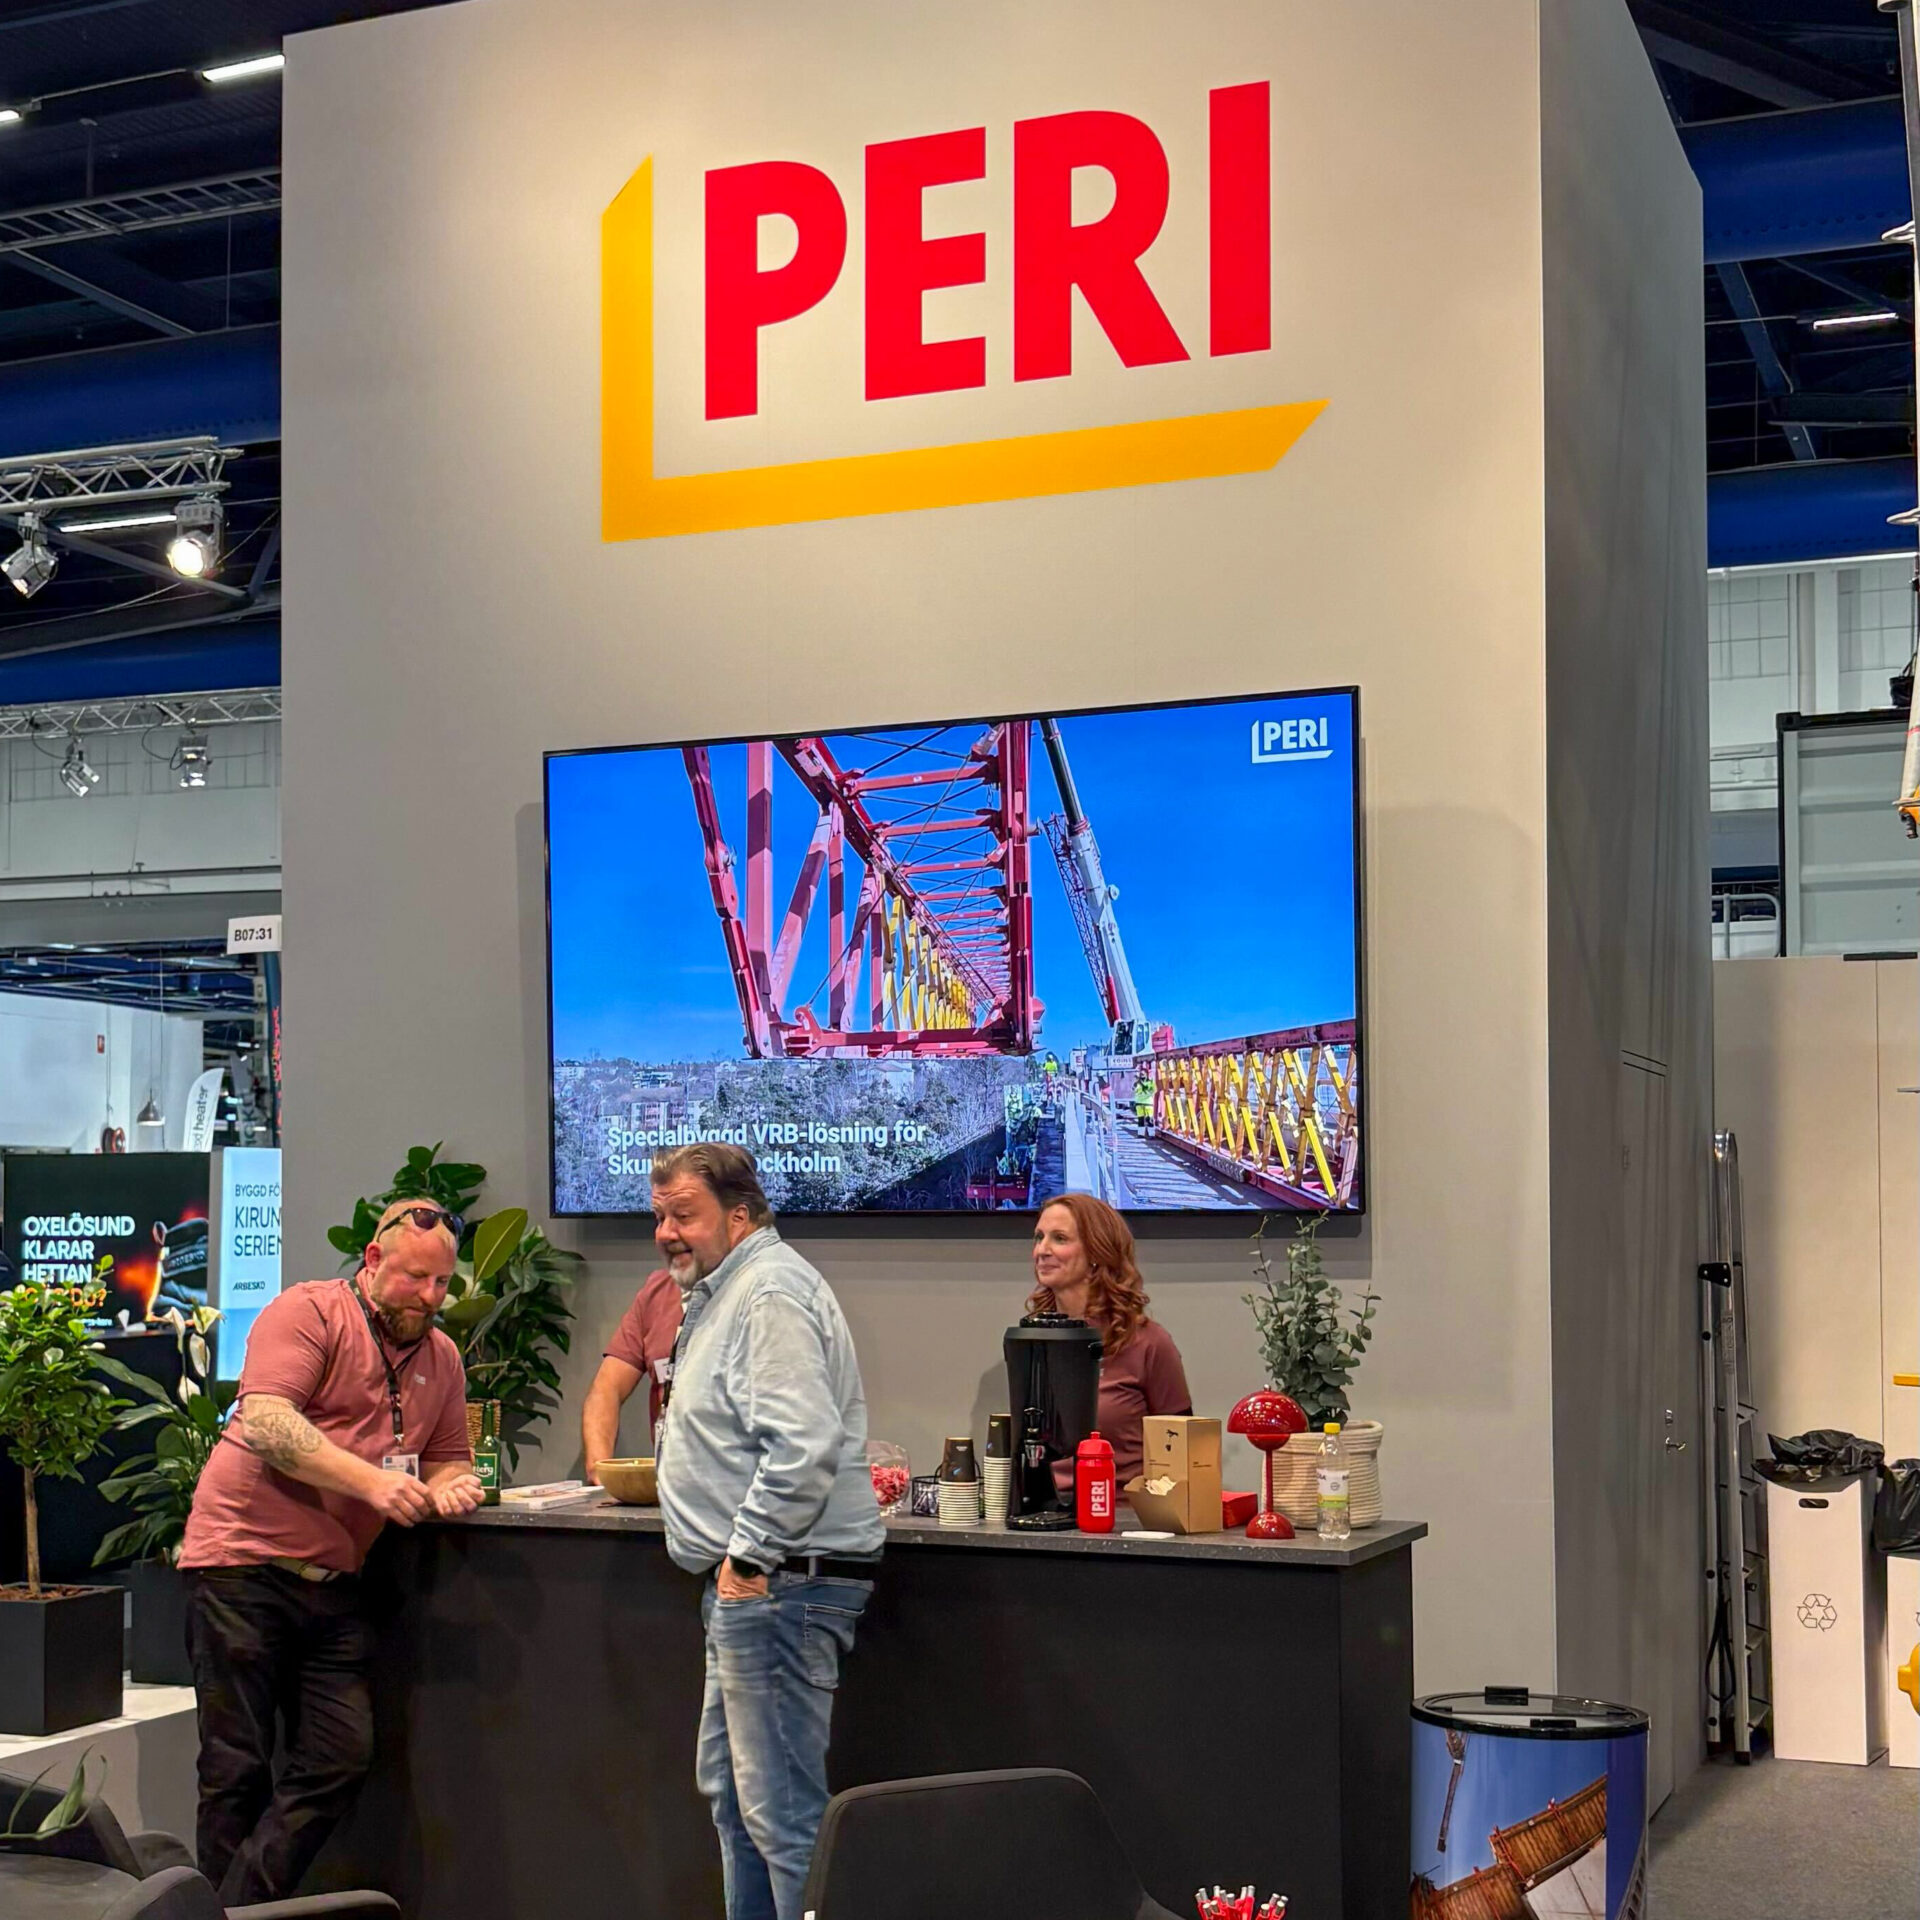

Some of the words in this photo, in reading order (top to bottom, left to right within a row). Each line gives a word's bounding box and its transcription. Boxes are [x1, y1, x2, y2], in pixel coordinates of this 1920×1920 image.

[705, 81, 1271, 420] PERI
[1264, 717, 1327, 751] PERI
[234, 927, 272, 941] B07:31
[608, 1123, 747, 1150] Specialbyggd
[752, 1121, 888, 1147] VRB-lösning
[894, 1120, 926, 1142] för
[235, 1183, 267, 1197] BYGGD
[24, 1212, 136, 1237] OXELÖSUND
[24, 1240, 95, 1260] KLARAR
[24, 1263, 92, 1283] HETTAN
[1091, 1481, 1105, 1512] PERI
